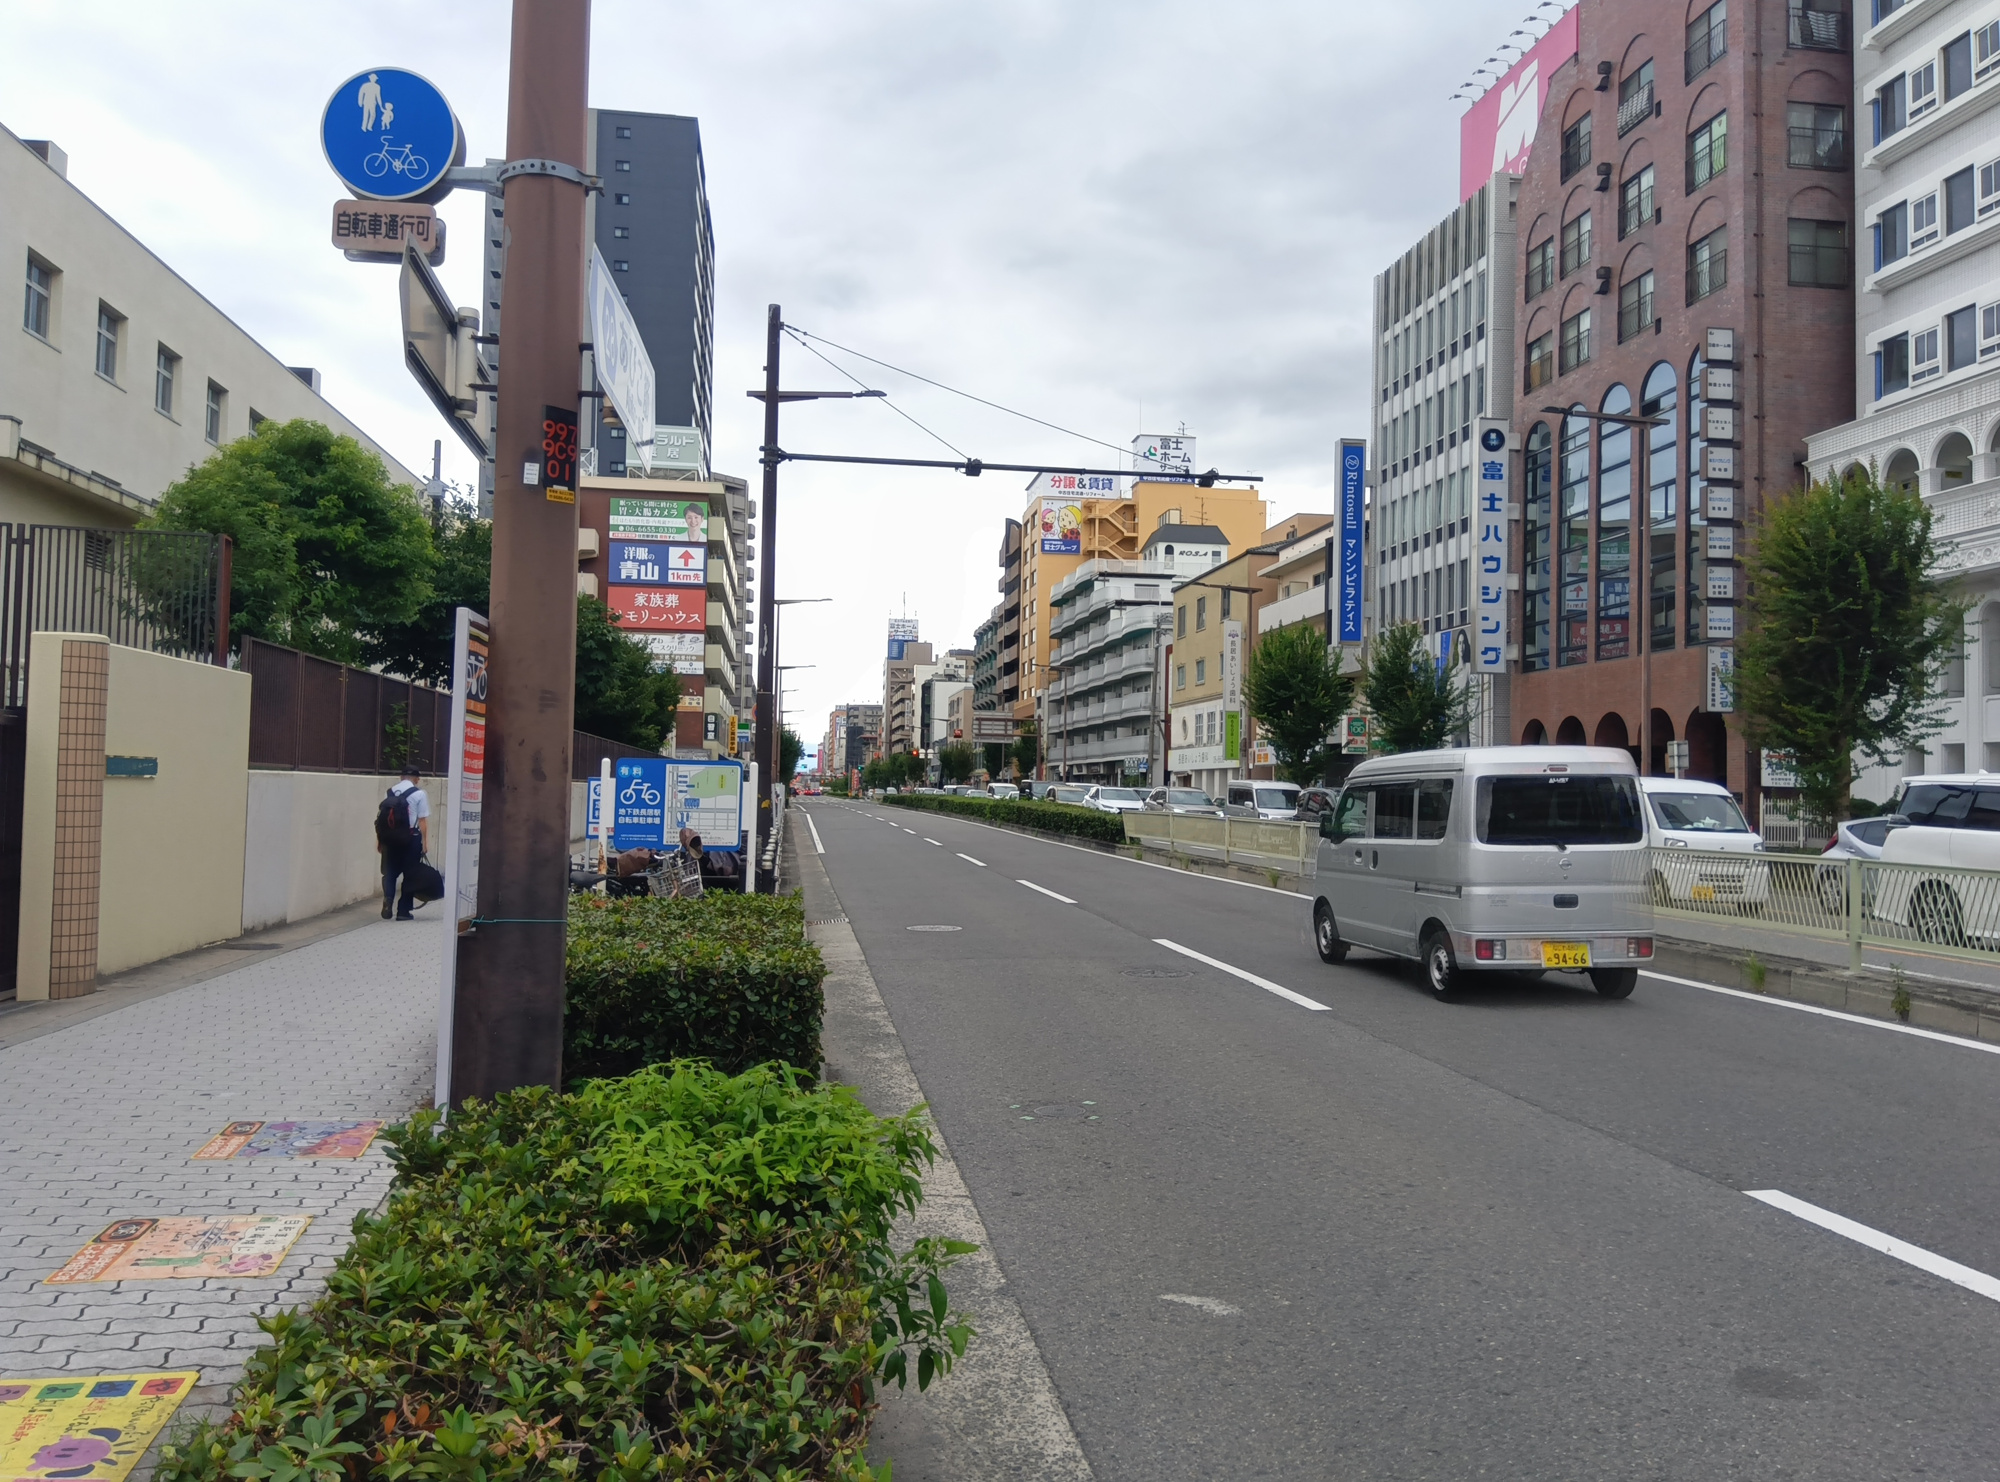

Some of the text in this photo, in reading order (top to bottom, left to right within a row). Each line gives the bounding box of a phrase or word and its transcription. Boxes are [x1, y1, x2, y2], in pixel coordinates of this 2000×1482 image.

[336, 212, 431, 242] 自転車通行可
[543, 419, 577, 444] 997
[654, 435, 694, 447] ラルド
[1160, 438, 1183, 451] 富士
[542, 438, 577, 462] 9C9
[1160, 452, 1191, 463] ホーム
[1160, 464, 1189, 473] サービス
[619, 507, 678, 517] 胃・大腸カメラ
[625, 525, 677, 533] 06-6655-0330
[624, 547, 655, 560] 洋服の
[1345, 471, 1357, 632] Rintosull マシンピラティス
[1481, 461, 1503, 665] 富士ハウジング
[619, 560, 659, 580] 青山
[671, 572, 701, 581] 1km先
[634, 592, 679, 608] 家族葬
[620, 767, 642, 776] 有料
[618, 808, 661, 816] 地下鉄長居駅
[618, 817, 661, 825] 自転車駐車場
[1553, 953, 1587, 965] 94-66
